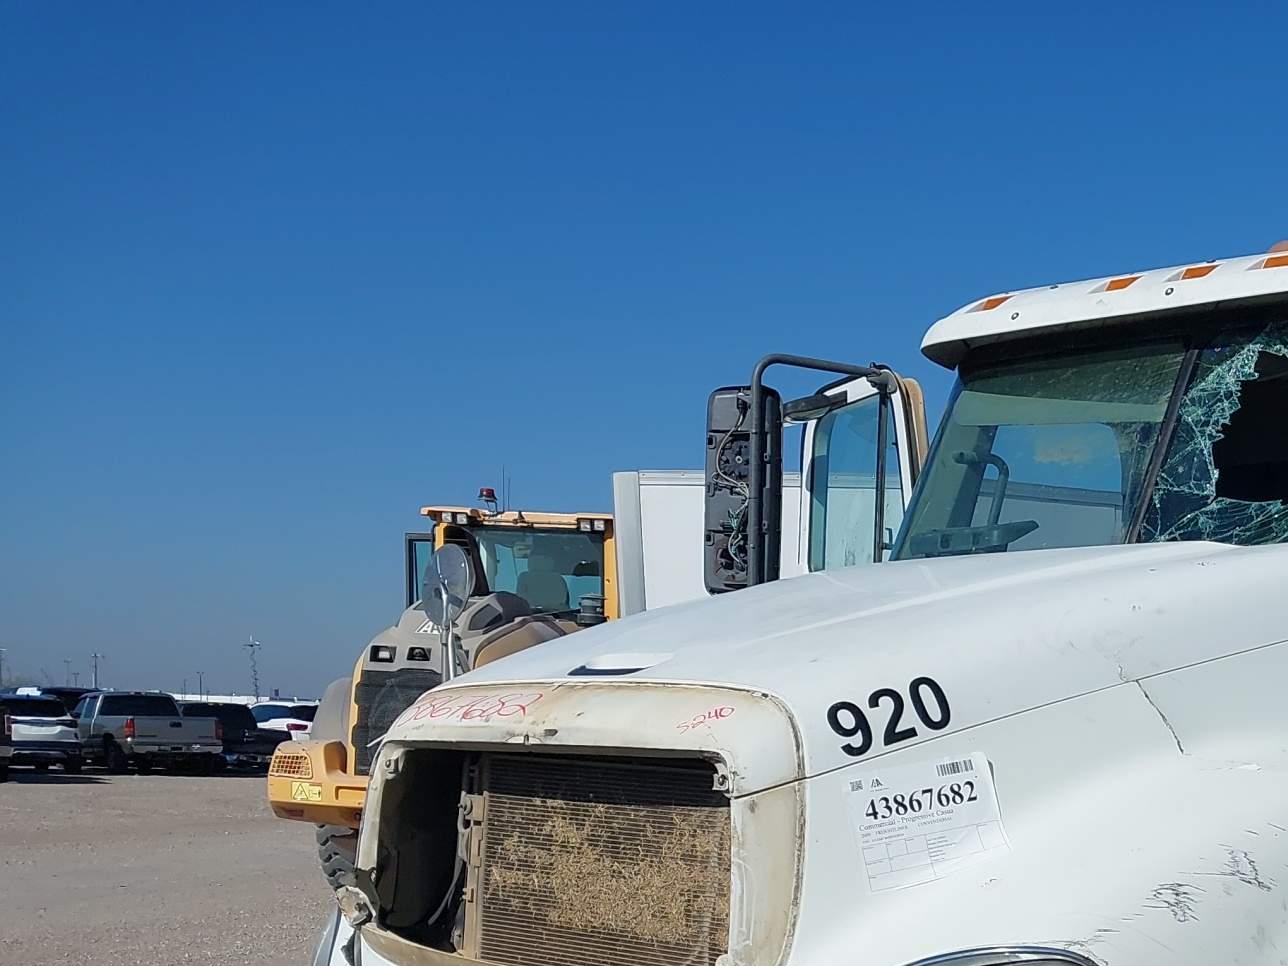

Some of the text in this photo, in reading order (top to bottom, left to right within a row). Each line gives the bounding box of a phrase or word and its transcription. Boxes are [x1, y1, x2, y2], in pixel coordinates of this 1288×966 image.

[826, 676, 951, 757] 920
[865, 780, 978, 820] 43867682
[858, 818, 896, 832] Commercial
